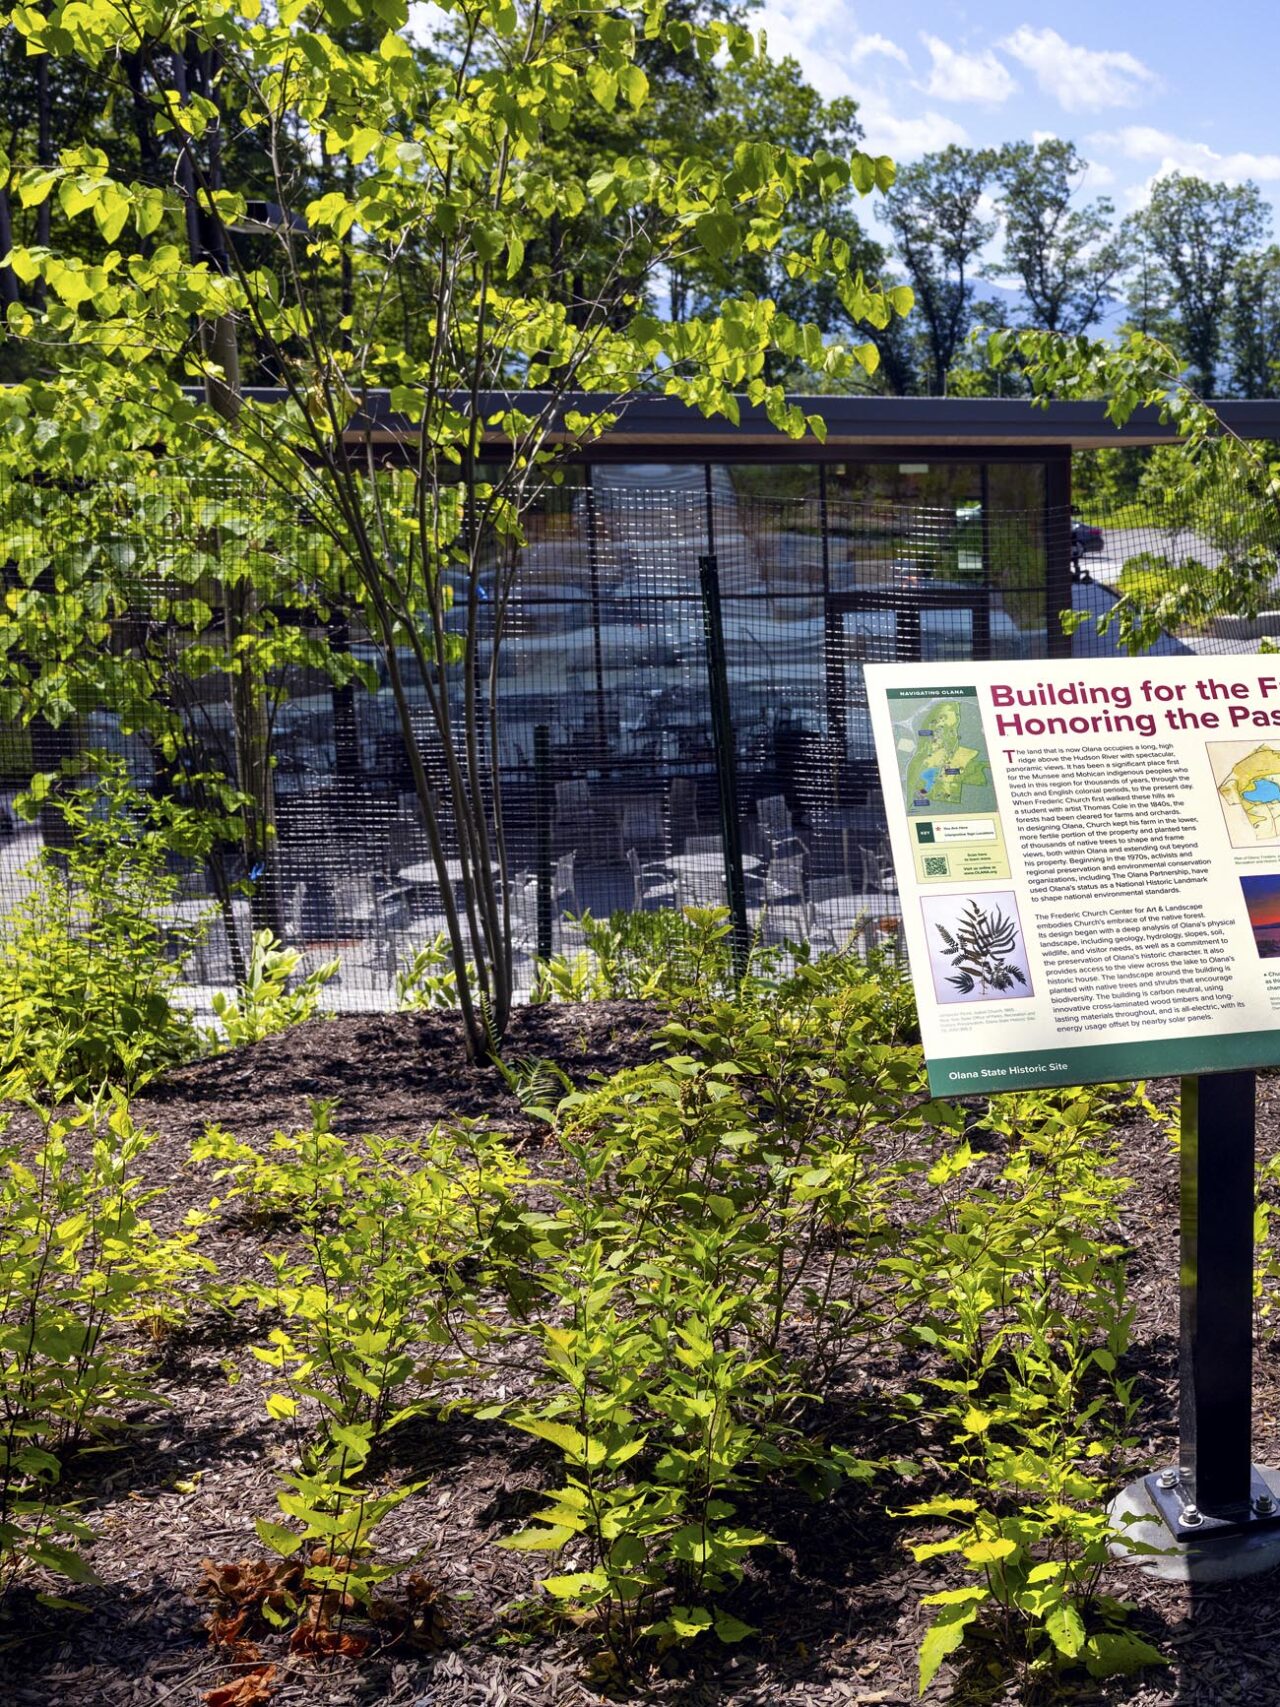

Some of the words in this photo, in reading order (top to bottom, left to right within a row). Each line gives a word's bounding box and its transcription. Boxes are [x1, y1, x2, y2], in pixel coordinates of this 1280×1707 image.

[991, 682, 1132, 708] Building
[1140, 680, 1186, 702] for
[1196, 679, 1249, 700] the
[996, 710, 1156, 736] Honoring
[1165, 708, 1219, 730] the
[1112, 761, 1146, 769] significant
[1037, 859, 1067, 867] property.
[1069, 857, 1105, 865] Beginning
[1051, 995, 1094, 1004] biodiversity.
[1115, 1009, 1157, 1018] throughout,
[1182, 1004, 1220, 1012] all-electric,
[1188, 1014, 1213, 1023] panels.
[949, 1072, 979, 1080] Olana
[981, 1069, 1007, 1077] State
[1009, 1064, 1047, 1075] Historic
[1049, 1063, 1068, 1071] Site
